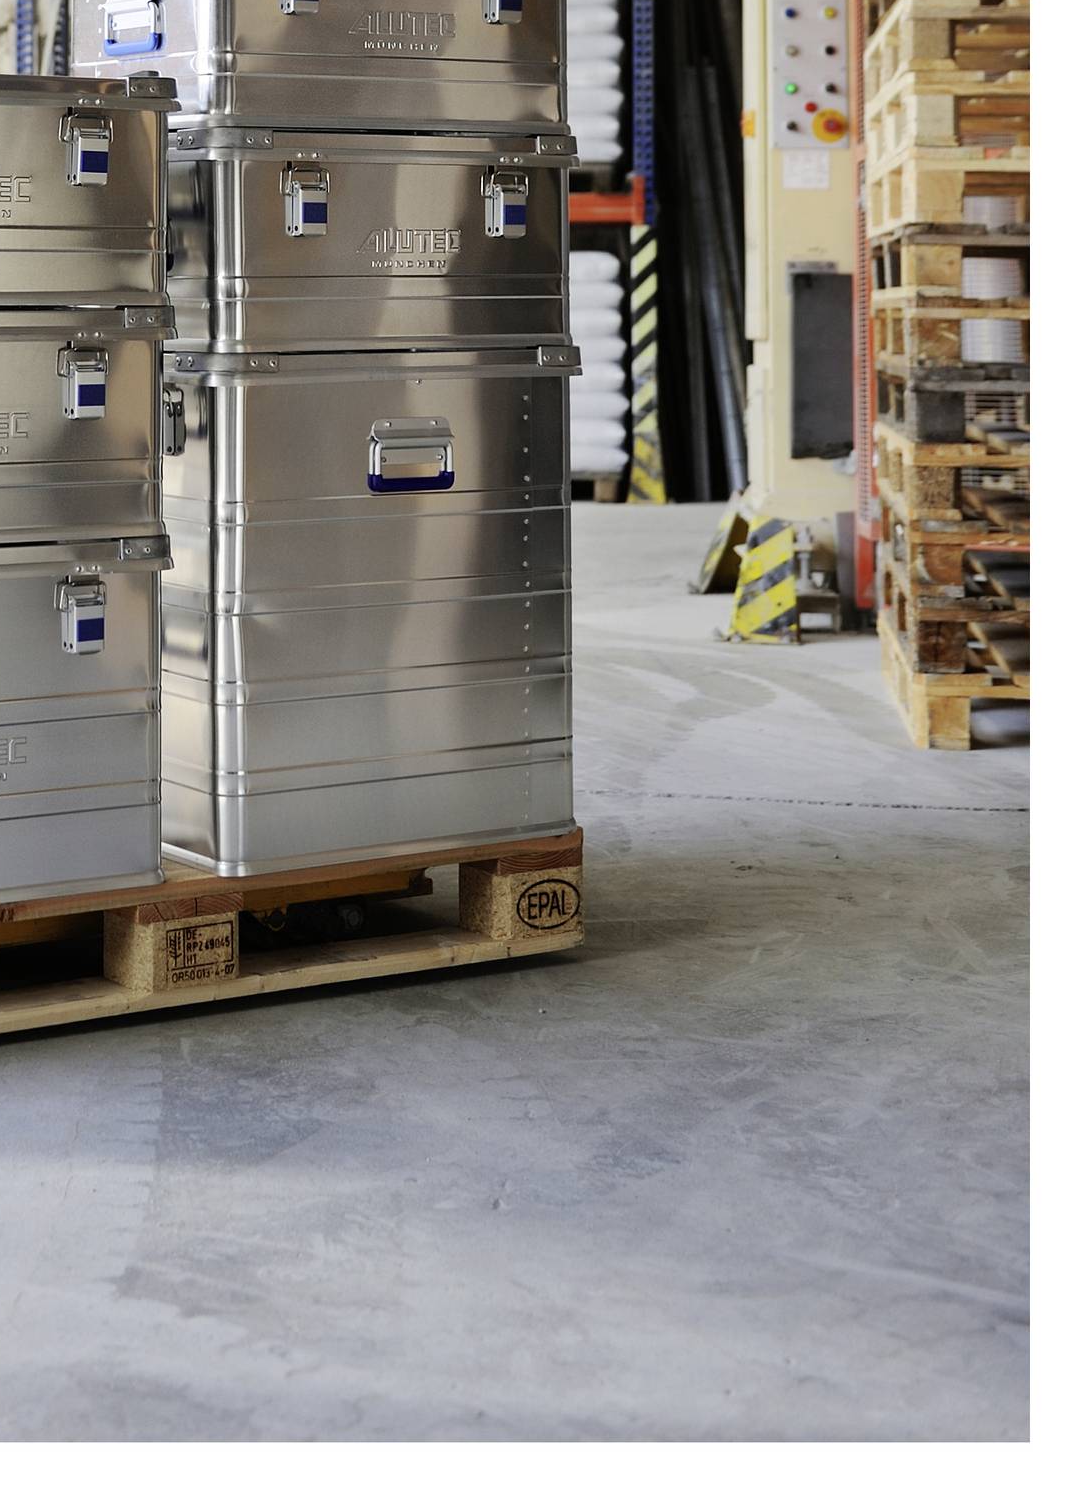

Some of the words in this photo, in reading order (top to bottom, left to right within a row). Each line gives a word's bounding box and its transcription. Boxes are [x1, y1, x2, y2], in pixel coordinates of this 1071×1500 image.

[348, 11, 457, 38] ALUTEC
[355, 228, 463, 254] ALUTEC
[527, 889, 572, 920] EPAL
